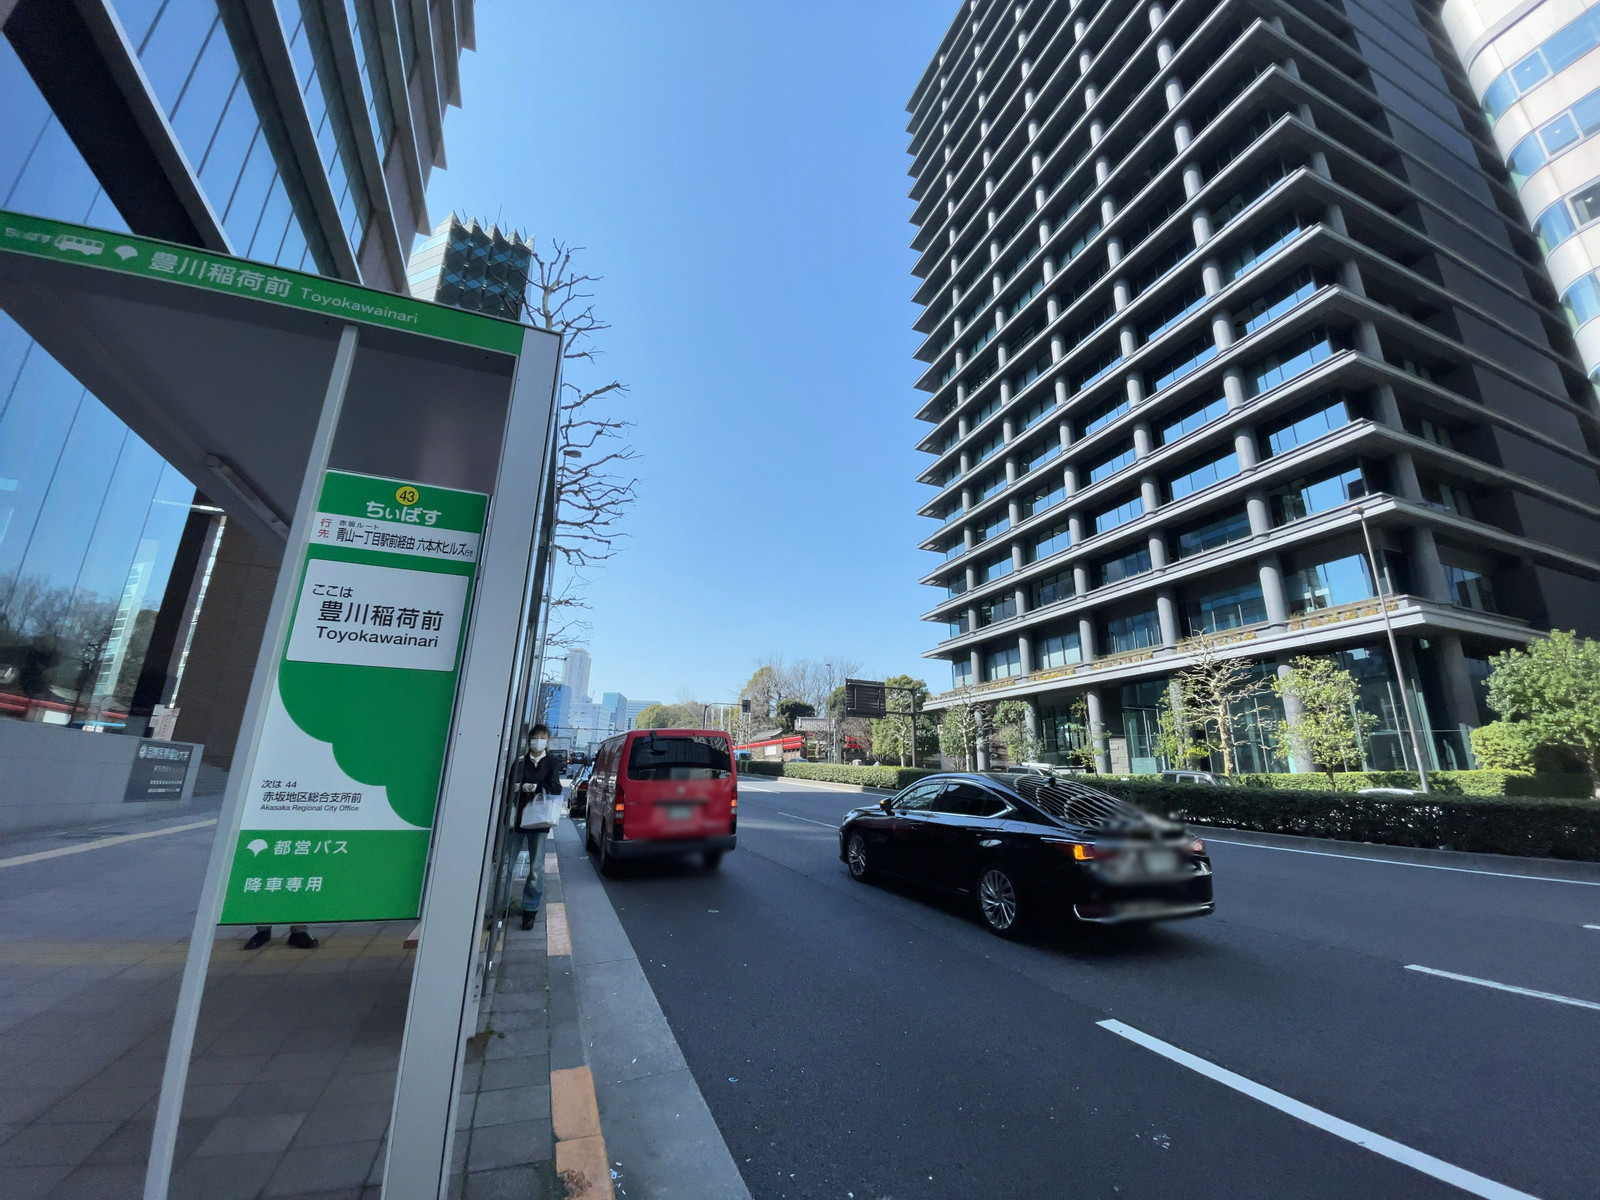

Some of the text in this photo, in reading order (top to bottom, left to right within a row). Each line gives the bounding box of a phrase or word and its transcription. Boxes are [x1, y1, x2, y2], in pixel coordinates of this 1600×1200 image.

[149, 250, 292, 298] 豊川稲荷前
[300, 287, 419, 325] Toyokawainari
[399, 489, 415, 503] 43
[365, 500, 442, 525] ちぃばす
[312, 583, 354, 598] ここは
[317, 600, 444, 632] 豊川稲荷前
[315, 625, 439, 648] Toyokawainari
[260, 779, 297, 789] 次は 44
[262, 791, 363, 804] 赤坂地区総合支所前
[292, 804, 323, 812] Regional
[324, 805, 338, 813] City
[273, 840, 349, 855] 都営バス
[243, 876, 323, 893] 降車専用
